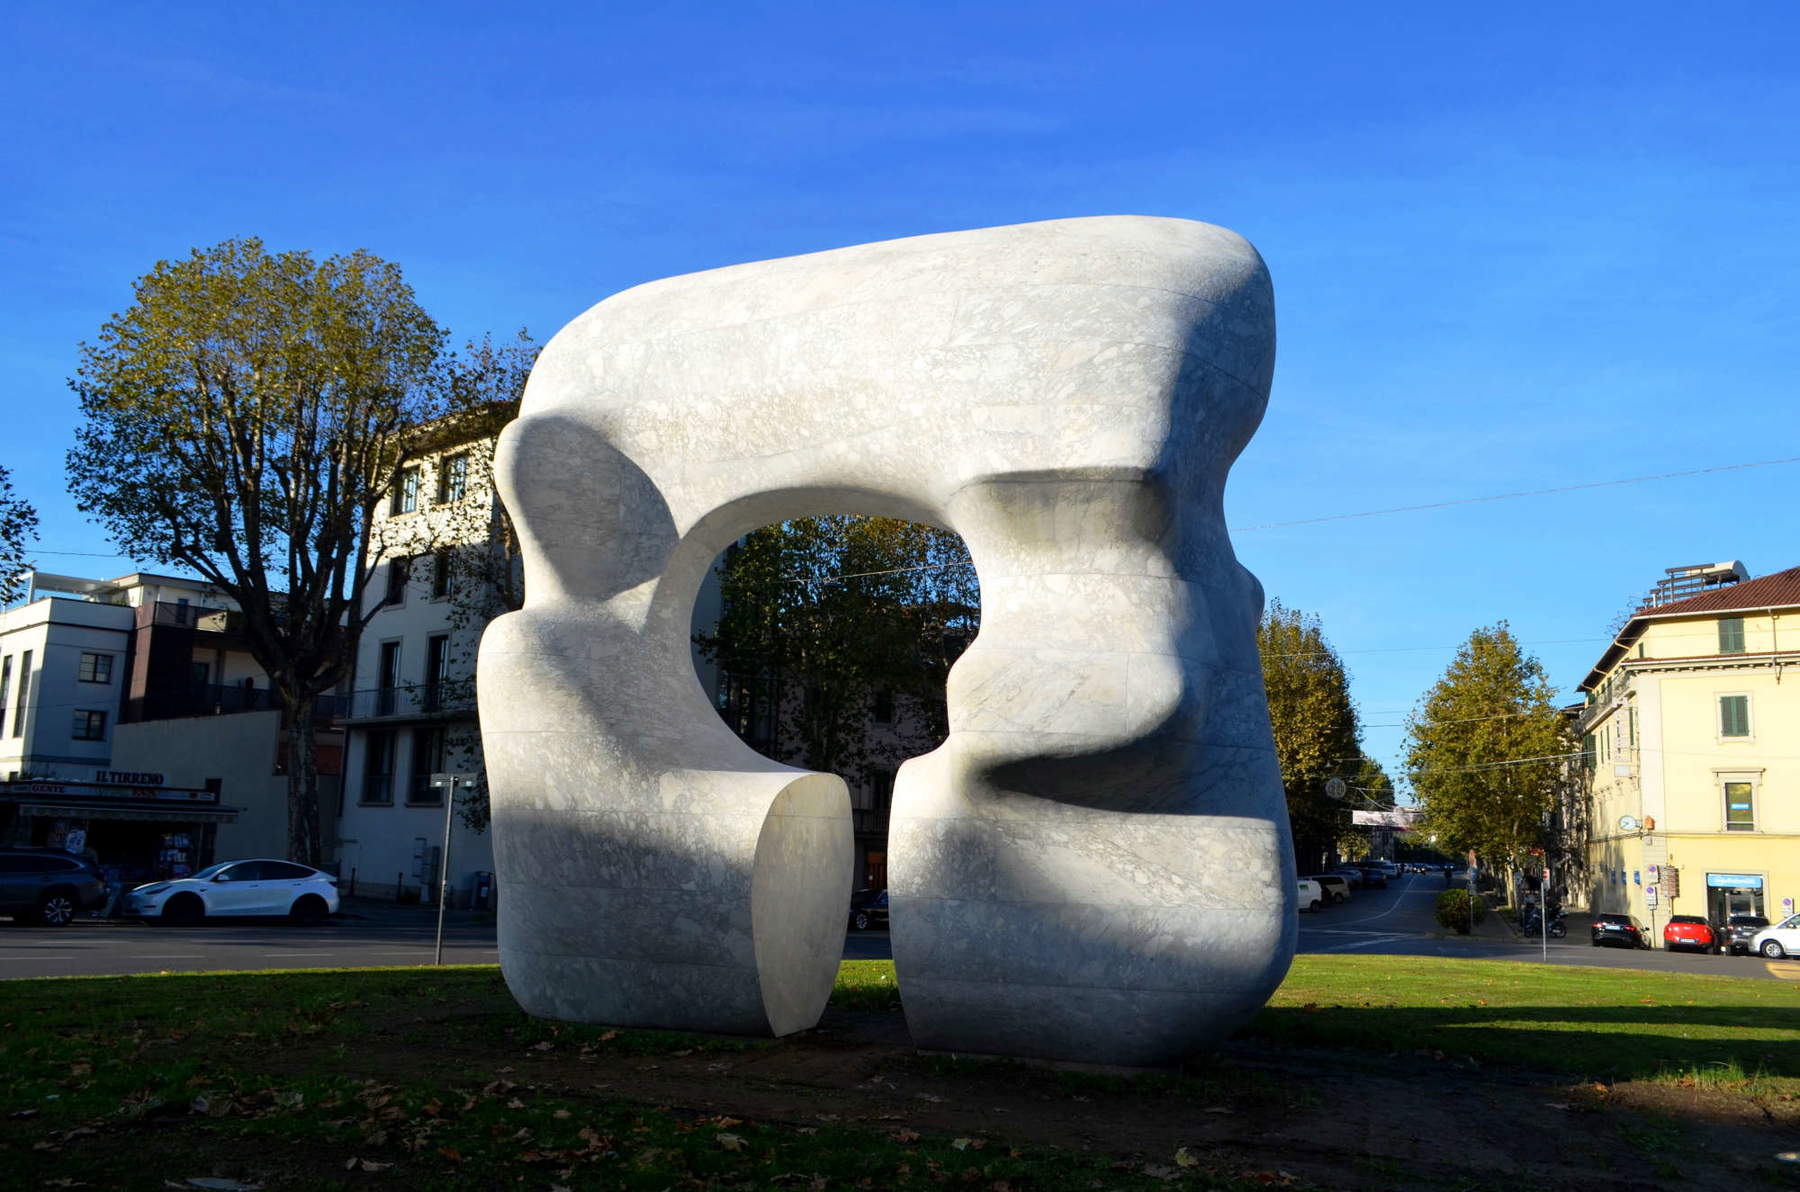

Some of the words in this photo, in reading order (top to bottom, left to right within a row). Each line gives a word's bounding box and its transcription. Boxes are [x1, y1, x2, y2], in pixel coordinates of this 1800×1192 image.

[96, 770, 108, 782] IL
[109, 771, 164, 785] TIRRENO
[31, 784, 65, 793] GENTE
